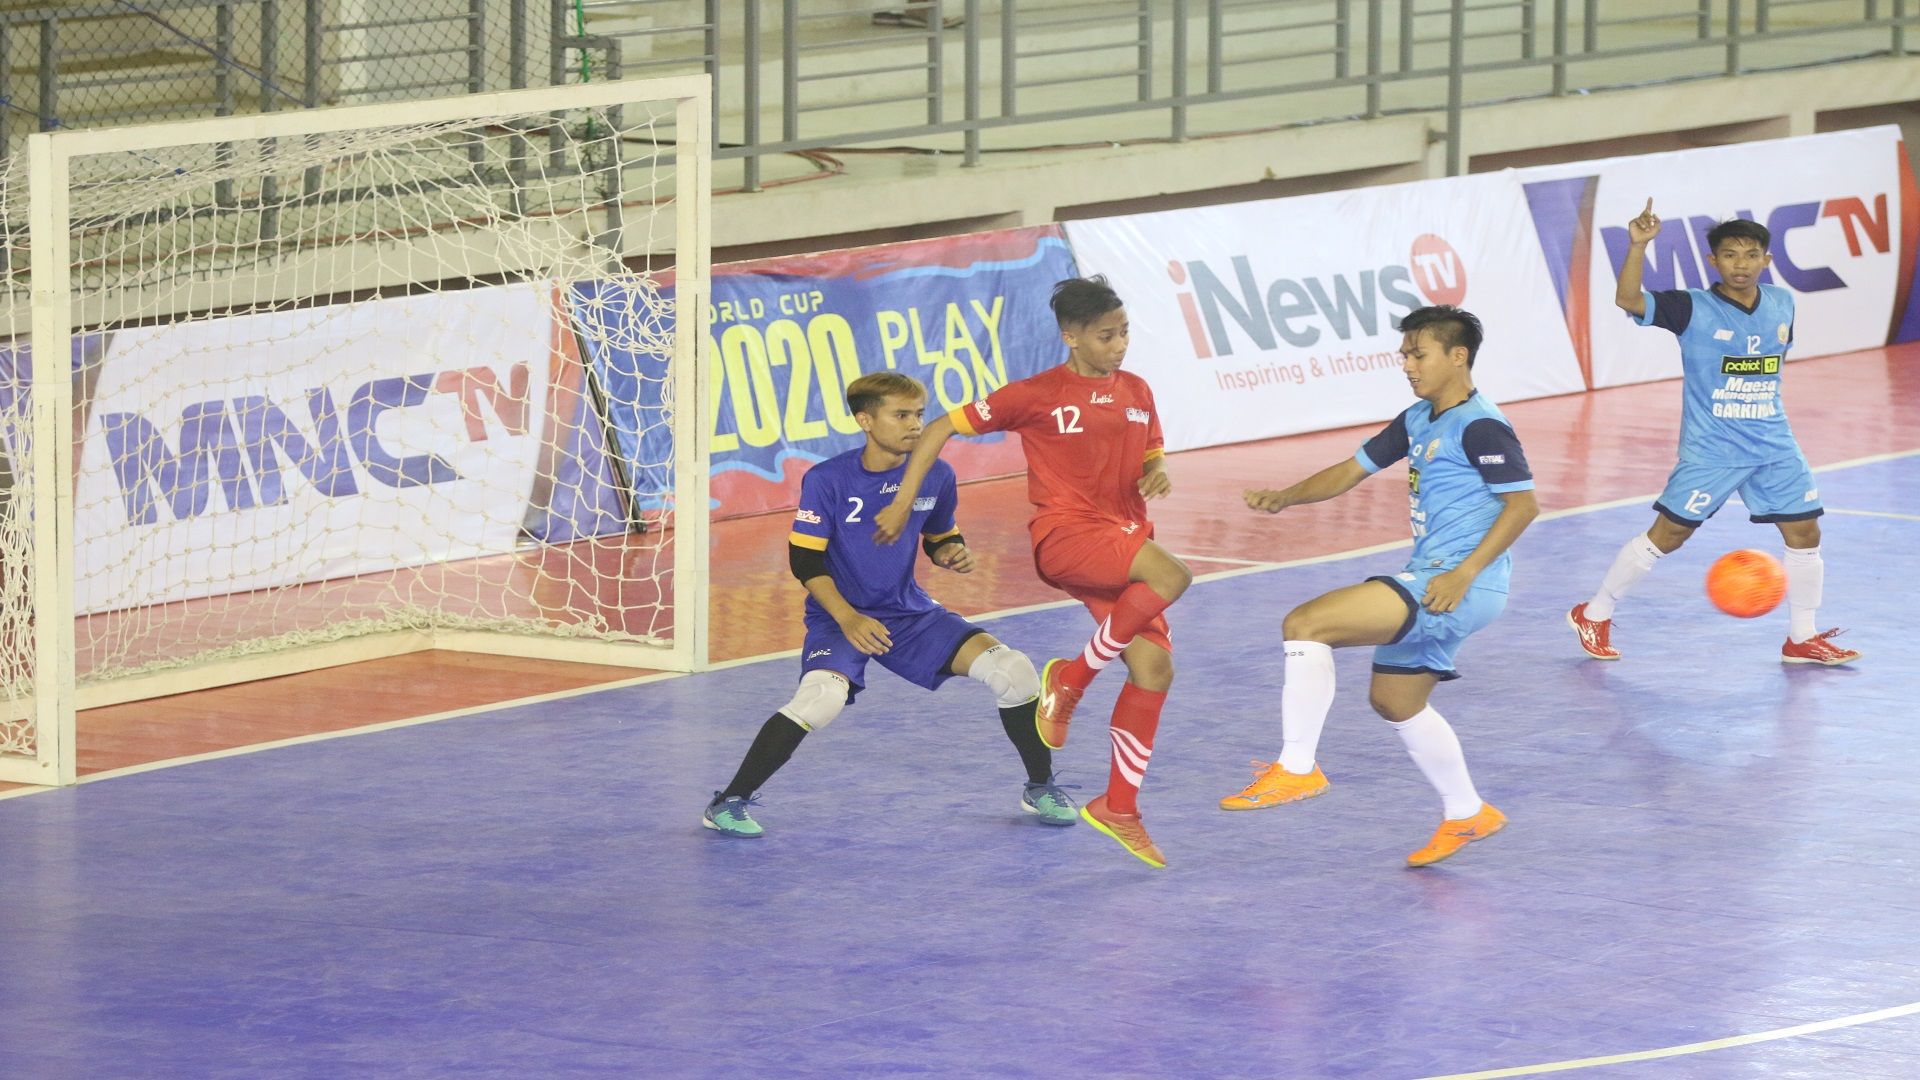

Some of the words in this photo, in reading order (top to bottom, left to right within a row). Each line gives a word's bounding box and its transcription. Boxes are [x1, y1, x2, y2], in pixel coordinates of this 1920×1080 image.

[709, 298, 765, 325] ORLD
[779, 290, 824, 315] CUP
[876, 296, 1004, 369] PLAY
[1747, 335, 1761, 355] 12
[709, 313, 864, 453] 2020
[933, 355, 1008, 412] ON
[1215, 357, 1305, 391] Inspiring
[1309, 356, 1324, 378] &
[1328, 346, 1405, 376] Informa
[1725, 377, 1777, 393] Maesa
[1051, 405, 1084, 434] 12
[100, 373, 466, 526] MNC
[845, 496, 864, 523] 2
[1684, 489, 1713, 515] 12
